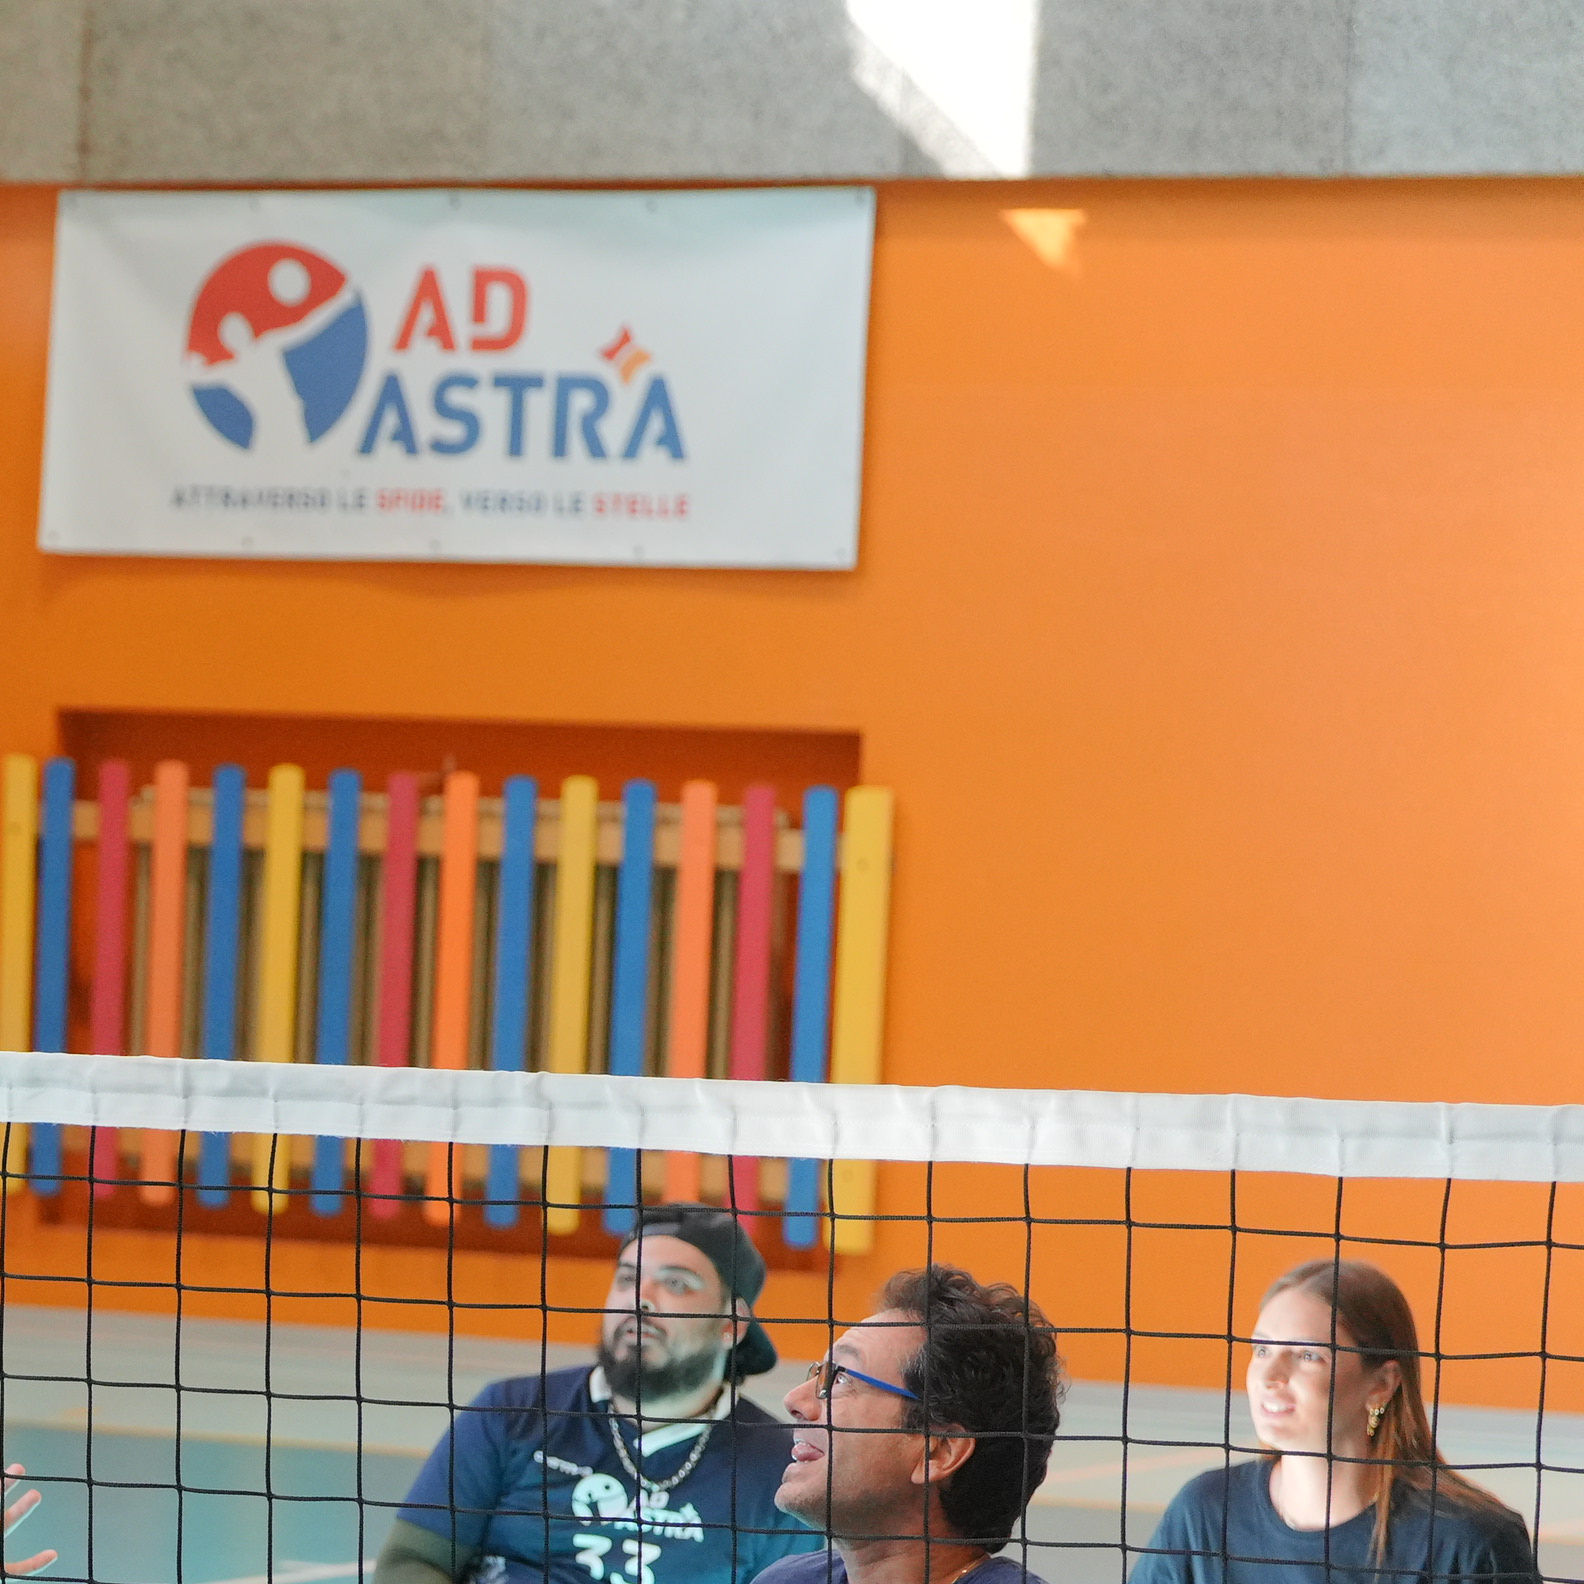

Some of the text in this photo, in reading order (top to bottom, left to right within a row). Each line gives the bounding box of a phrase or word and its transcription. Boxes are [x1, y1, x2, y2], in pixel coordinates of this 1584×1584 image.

[392, 264, 530, 353] AD
[354, 371, 689, 463] ASTRA
[170, 486, 329, 511] ATTRAVERSO
[335, 486, 369, 514] LE
[459, 488, 547, 516] VERSO
[552, 490, 587, 518] LE
[593, 491, 690, 519] STELLE
